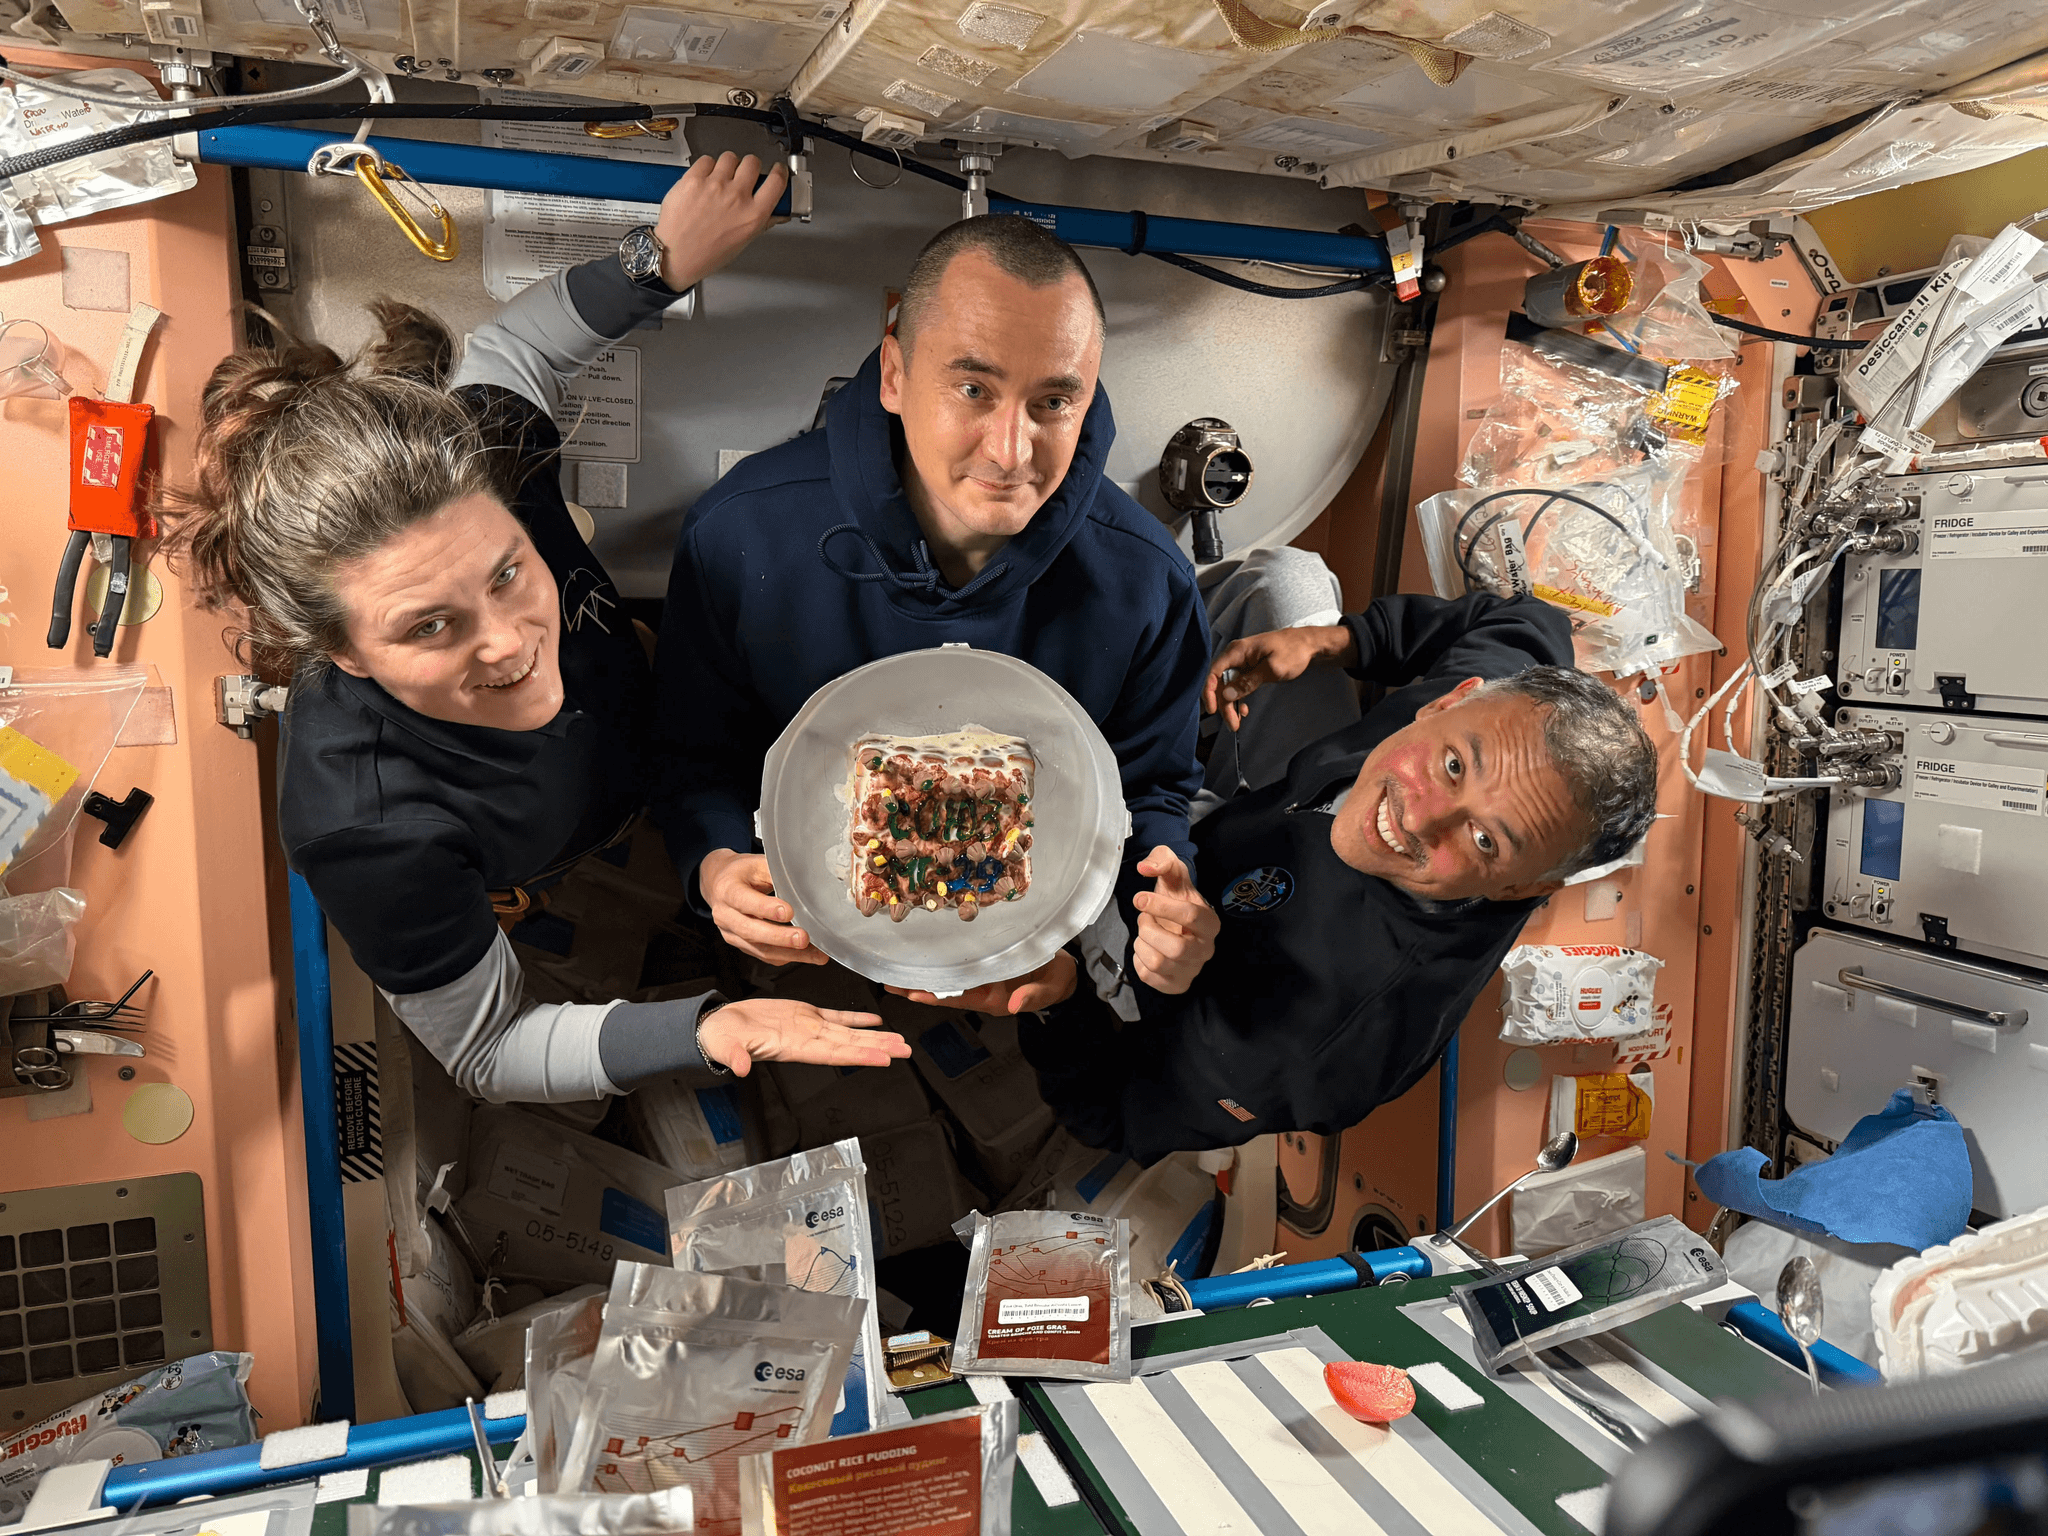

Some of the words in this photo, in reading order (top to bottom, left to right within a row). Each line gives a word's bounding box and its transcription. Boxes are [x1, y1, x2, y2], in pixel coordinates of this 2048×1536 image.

[1858, 309, 1918, 378] Desiccant
[1930, 271, 1953, 294] Kit
[601, 419, 631, 427] direction
[579, 440, 608, 448] position.
[103, 436, 113, 477] EMERGENCY
[1934, 517, 1974, 529] FRIDGE
[1508, 559, 1524, 590] Water
[1916, 760, 1956, 774] FRIDGE
[1931, 775, 1951, 784] Refrigerator
[1988, 782, 1999, 790] Galley
[2007, 785, 2039, 795] Experimentation)
[1873, 879, 1890, 887] POWER
[1561, 945, 1621, 957] HUGGIES
[1580, 987, 1603, 995] HUGGIES
[1655, 1013, 1666, 1021] USE
[344, 1077, 354, 1111] BEFORE
[353, 1076, 364, 1117] CLOSURE
[346, 1112, 356, 1150] REMOVE
[355, 1118, 365, 1149] HATCH
[519, 1171, 541, 1184] TRASH
[541, 1178, 556, 1189] BAG
[820, 1206, 845, 1222] esa
[1026, 1324, 1045, 1332] FOIE
[165, 1364, 182, 1377] 64
[774, 1366, 806, 1382] esa
[786, 1459, 837, 1479] COCONUT
[838, 1454, 865, 1468] RICE
[866, 1445, 918, 1462] PUDDING
[855, 1463, 906, 1482] рисовый
[908, 1456, 949, 1471] пудинг
